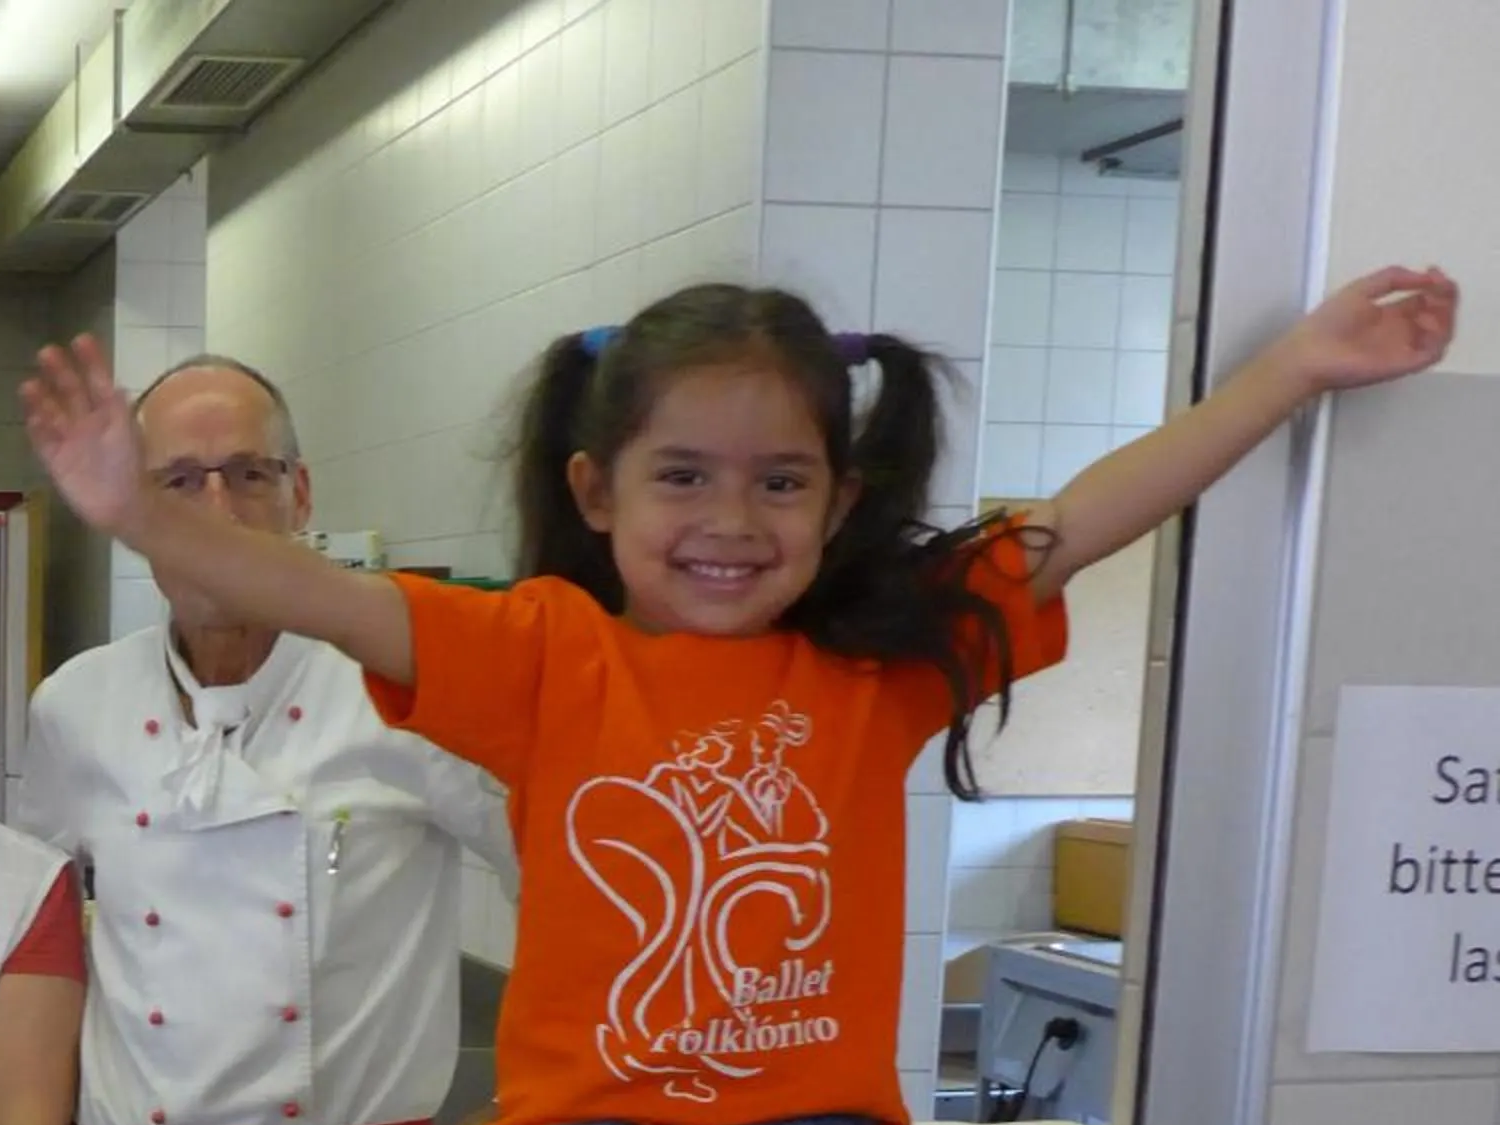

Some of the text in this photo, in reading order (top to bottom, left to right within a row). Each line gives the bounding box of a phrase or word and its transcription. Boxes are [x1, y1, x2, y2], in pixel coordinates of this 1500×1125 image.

[1433, 754, 1500, 804] Sa
[1389, 842, 1500, 894] bitte
[733, 958, 834, 1006] Ballet
